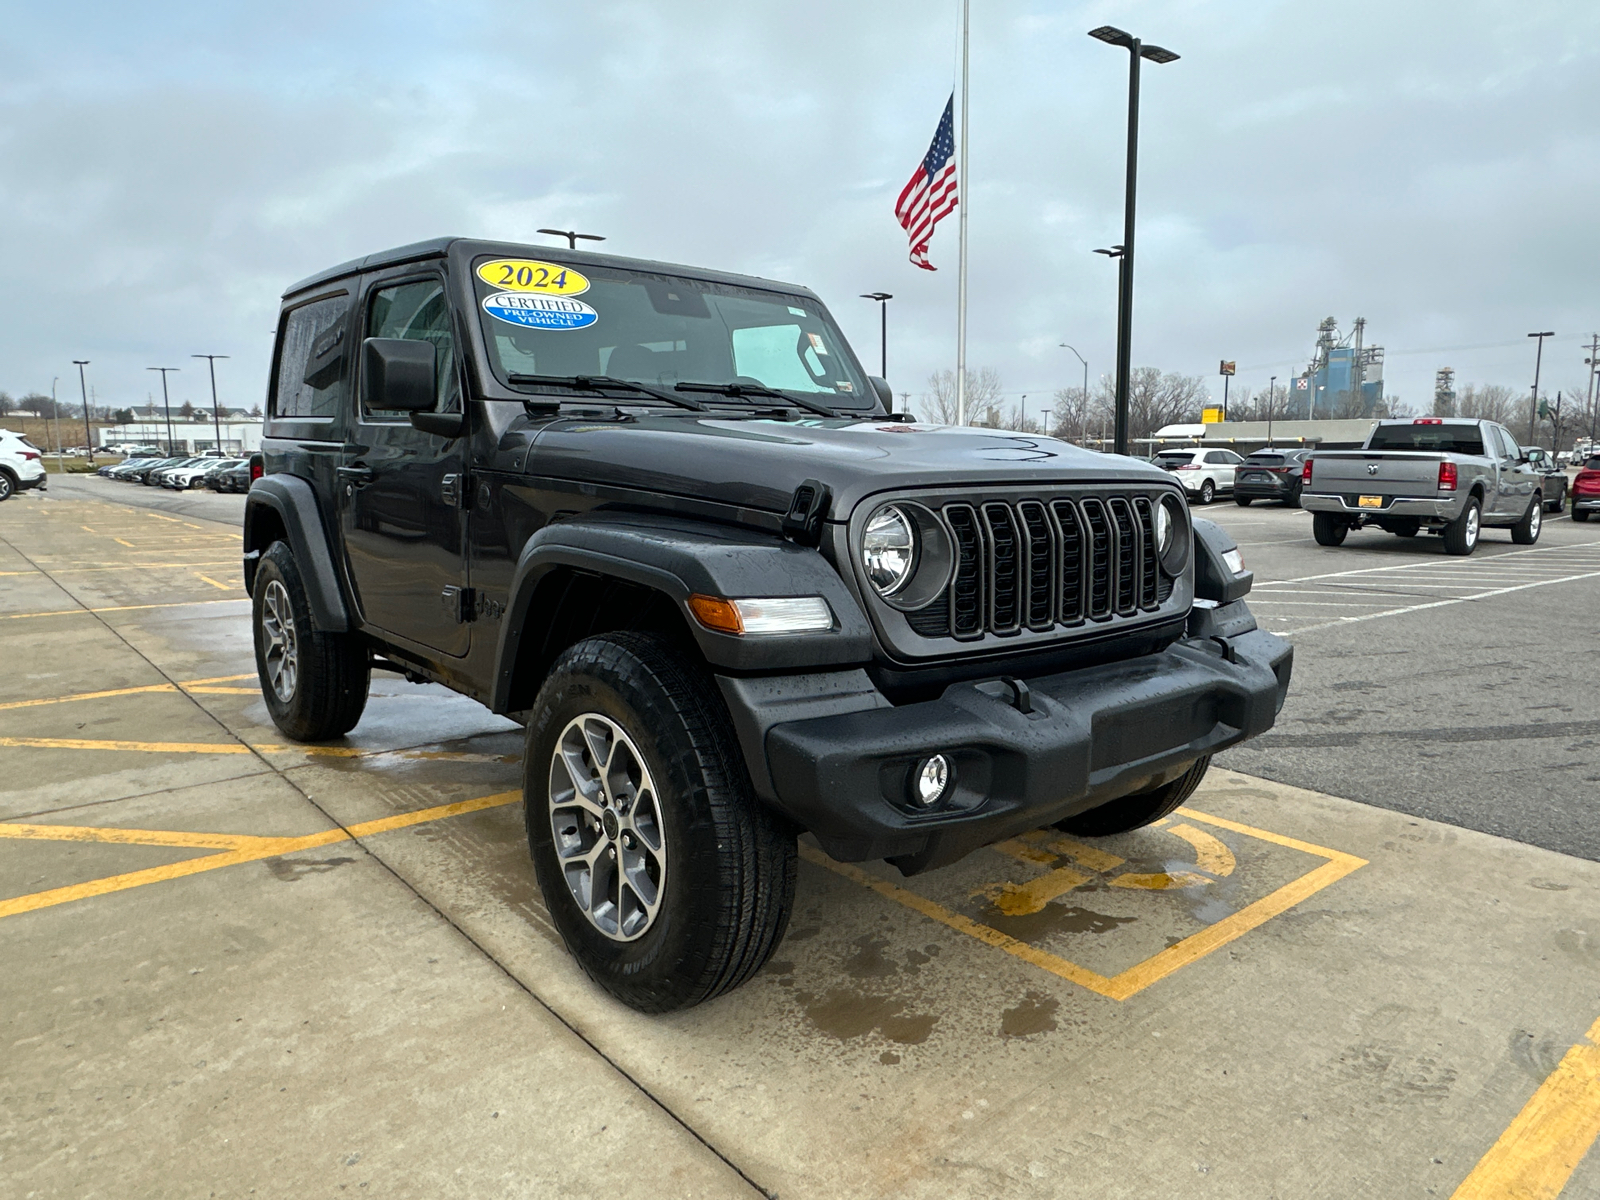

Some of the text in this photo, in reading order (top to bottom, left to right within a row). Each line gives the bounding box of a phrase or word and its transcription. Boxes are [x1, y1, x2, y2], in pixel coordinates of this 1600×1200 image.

[498, 264, 567, 289] 2024
[495, 296, 583, 313] CERTIFIED
[504, 309, 583, 320] PRE-OWNED
[518, 316, 575, 326] VEHICLE
